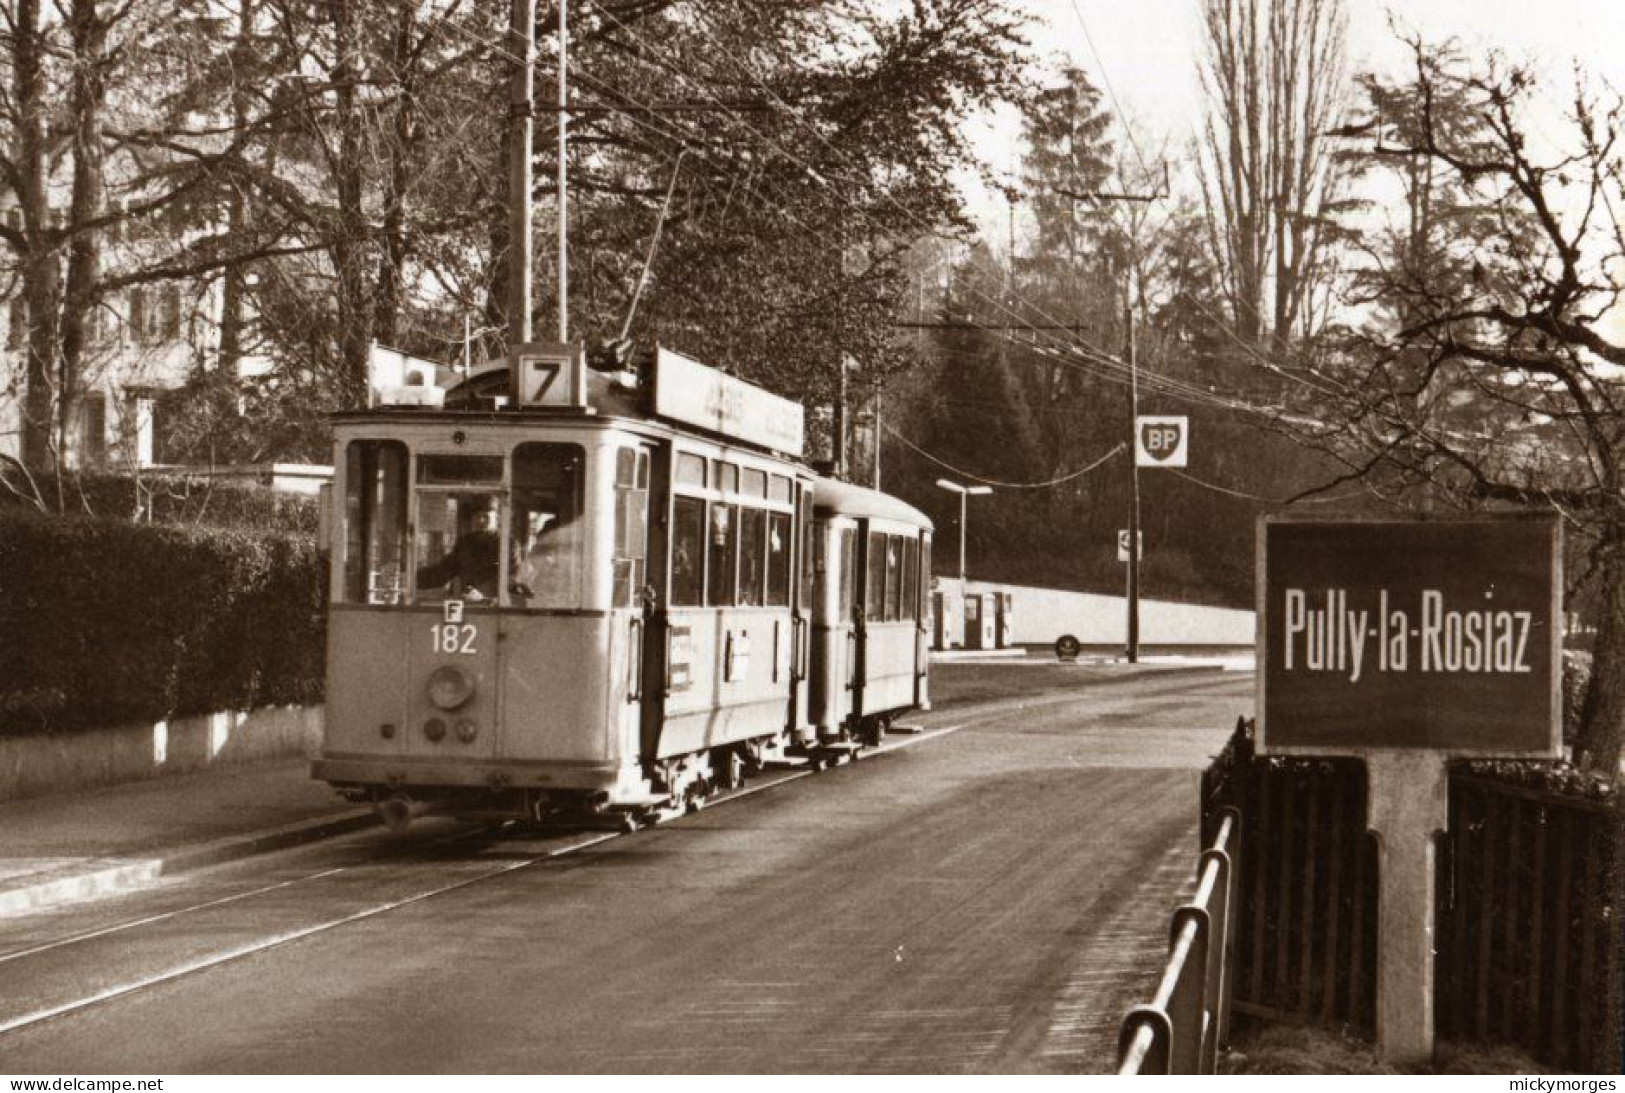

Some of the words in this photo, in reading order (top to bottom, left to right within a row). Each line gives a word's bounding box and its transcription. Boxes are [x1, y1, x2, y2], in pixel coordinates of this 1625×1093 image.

[532, 362, 561, 402] 7
[1147, 428, 1178, 451] BP
[430, 625, 478, 654] 182
[1284, 588, 1533, 684] Pully-la-Rosiaz
